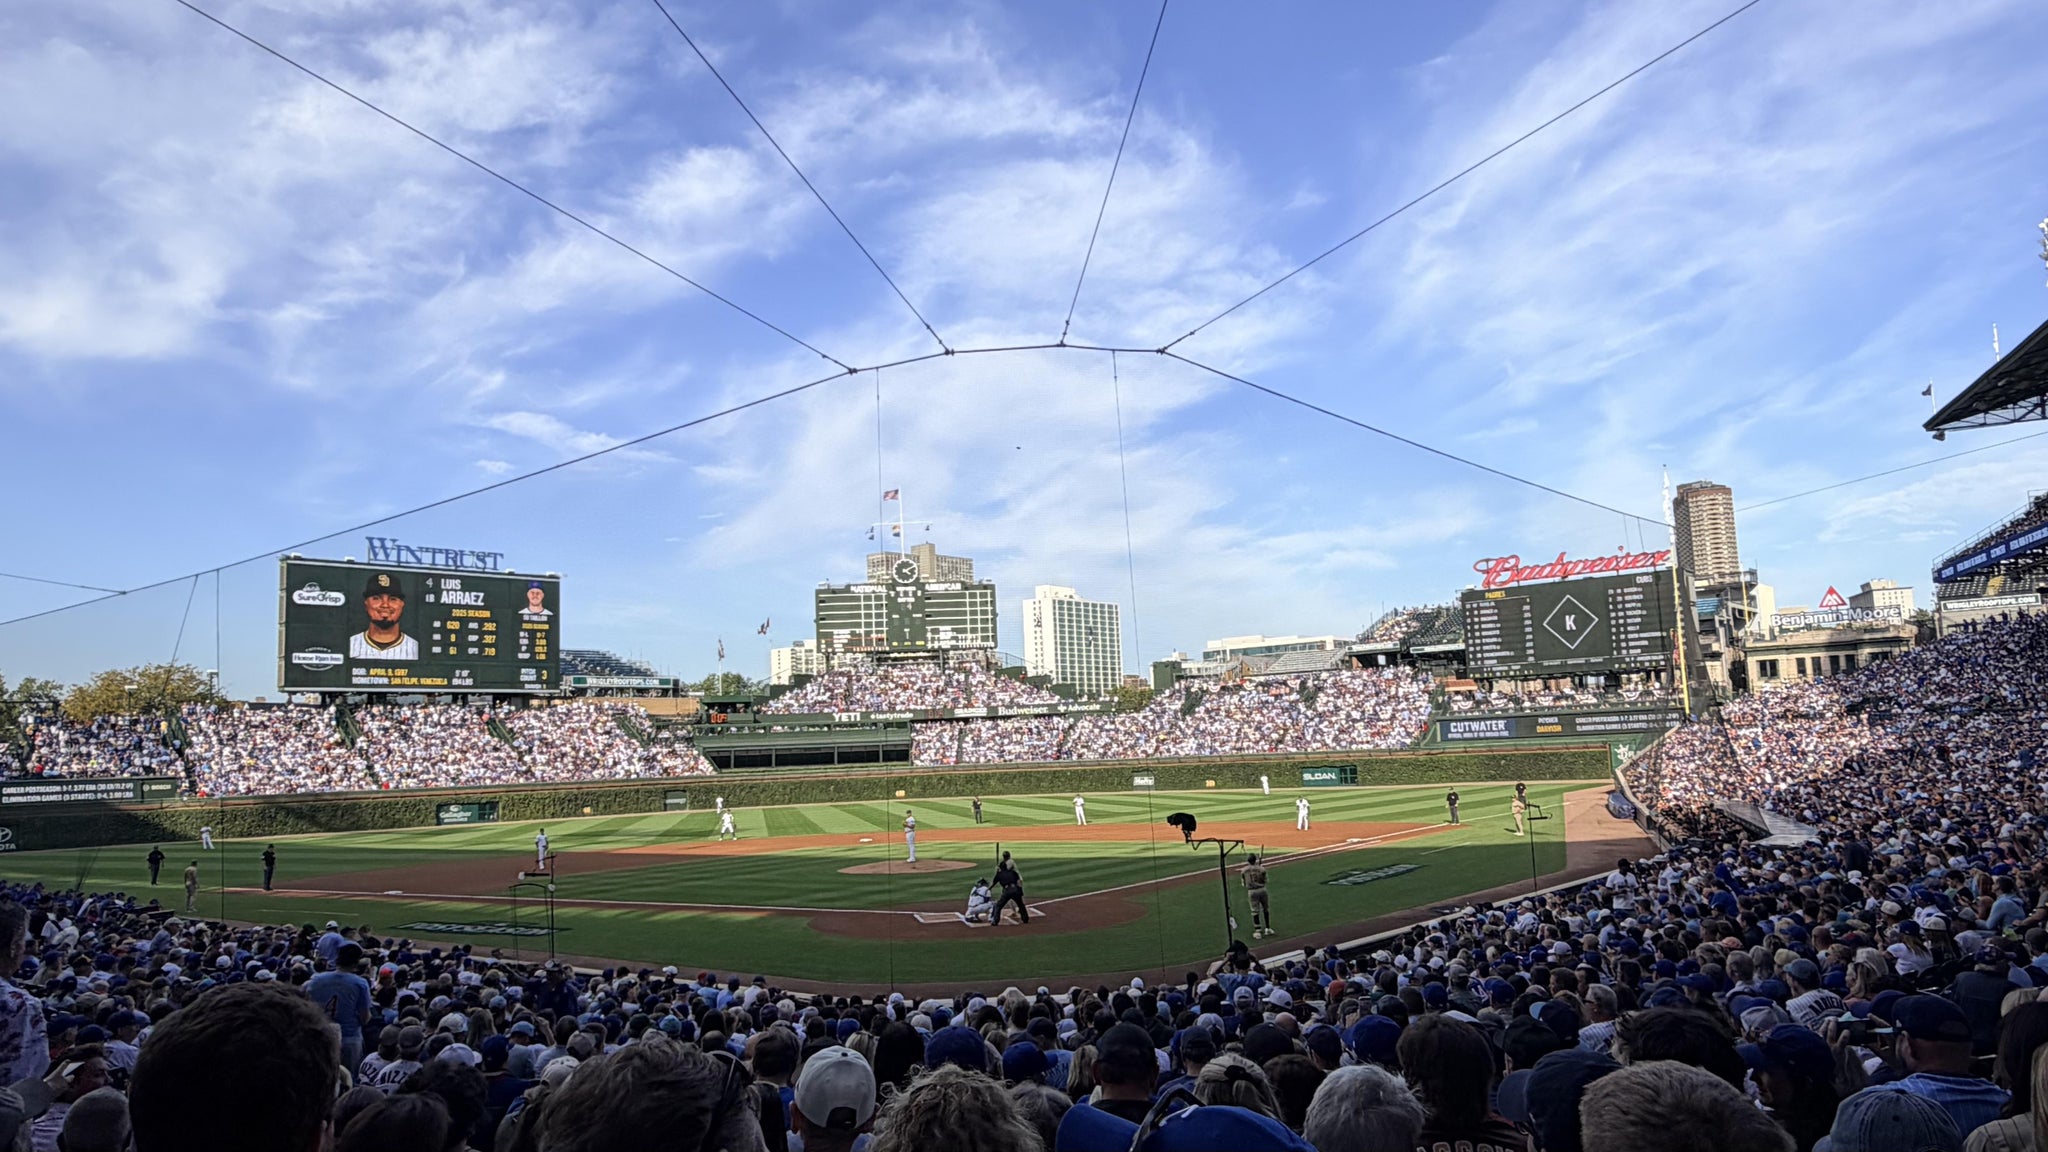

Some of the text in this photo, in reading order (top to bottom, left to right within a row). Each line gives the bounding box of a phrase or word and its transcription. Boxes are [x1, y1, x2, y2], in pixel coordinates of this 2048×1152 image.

[365, 536, 504, 570] WINTRUST
[1473, 546, 1671, 588] Budweiser
[425, 577, 433, 588] 4
[441, 578, 461, 590] LUIS
[1635, 575, 1653, 584] CUBS
[850, 584, 887, 592] NATIONAL
[925, 583, 961, 591] AMERICAN
[440, 590, 484, 606] ARRAEZ
[1771, 607, 1900, 627] Benjamin Moore
[1564, 615, 1576, 631] K
[998, 706, 1049, 716] Budweiser
[1068, 704, 1101, 712] Advocate
[832, 712, 861, 722] YETI
[875, 711, 914, 721] tastytrade
[1450, 720, 1505, 732] CUTWATER
[1303, 772, 1337, 781] SLOAN
